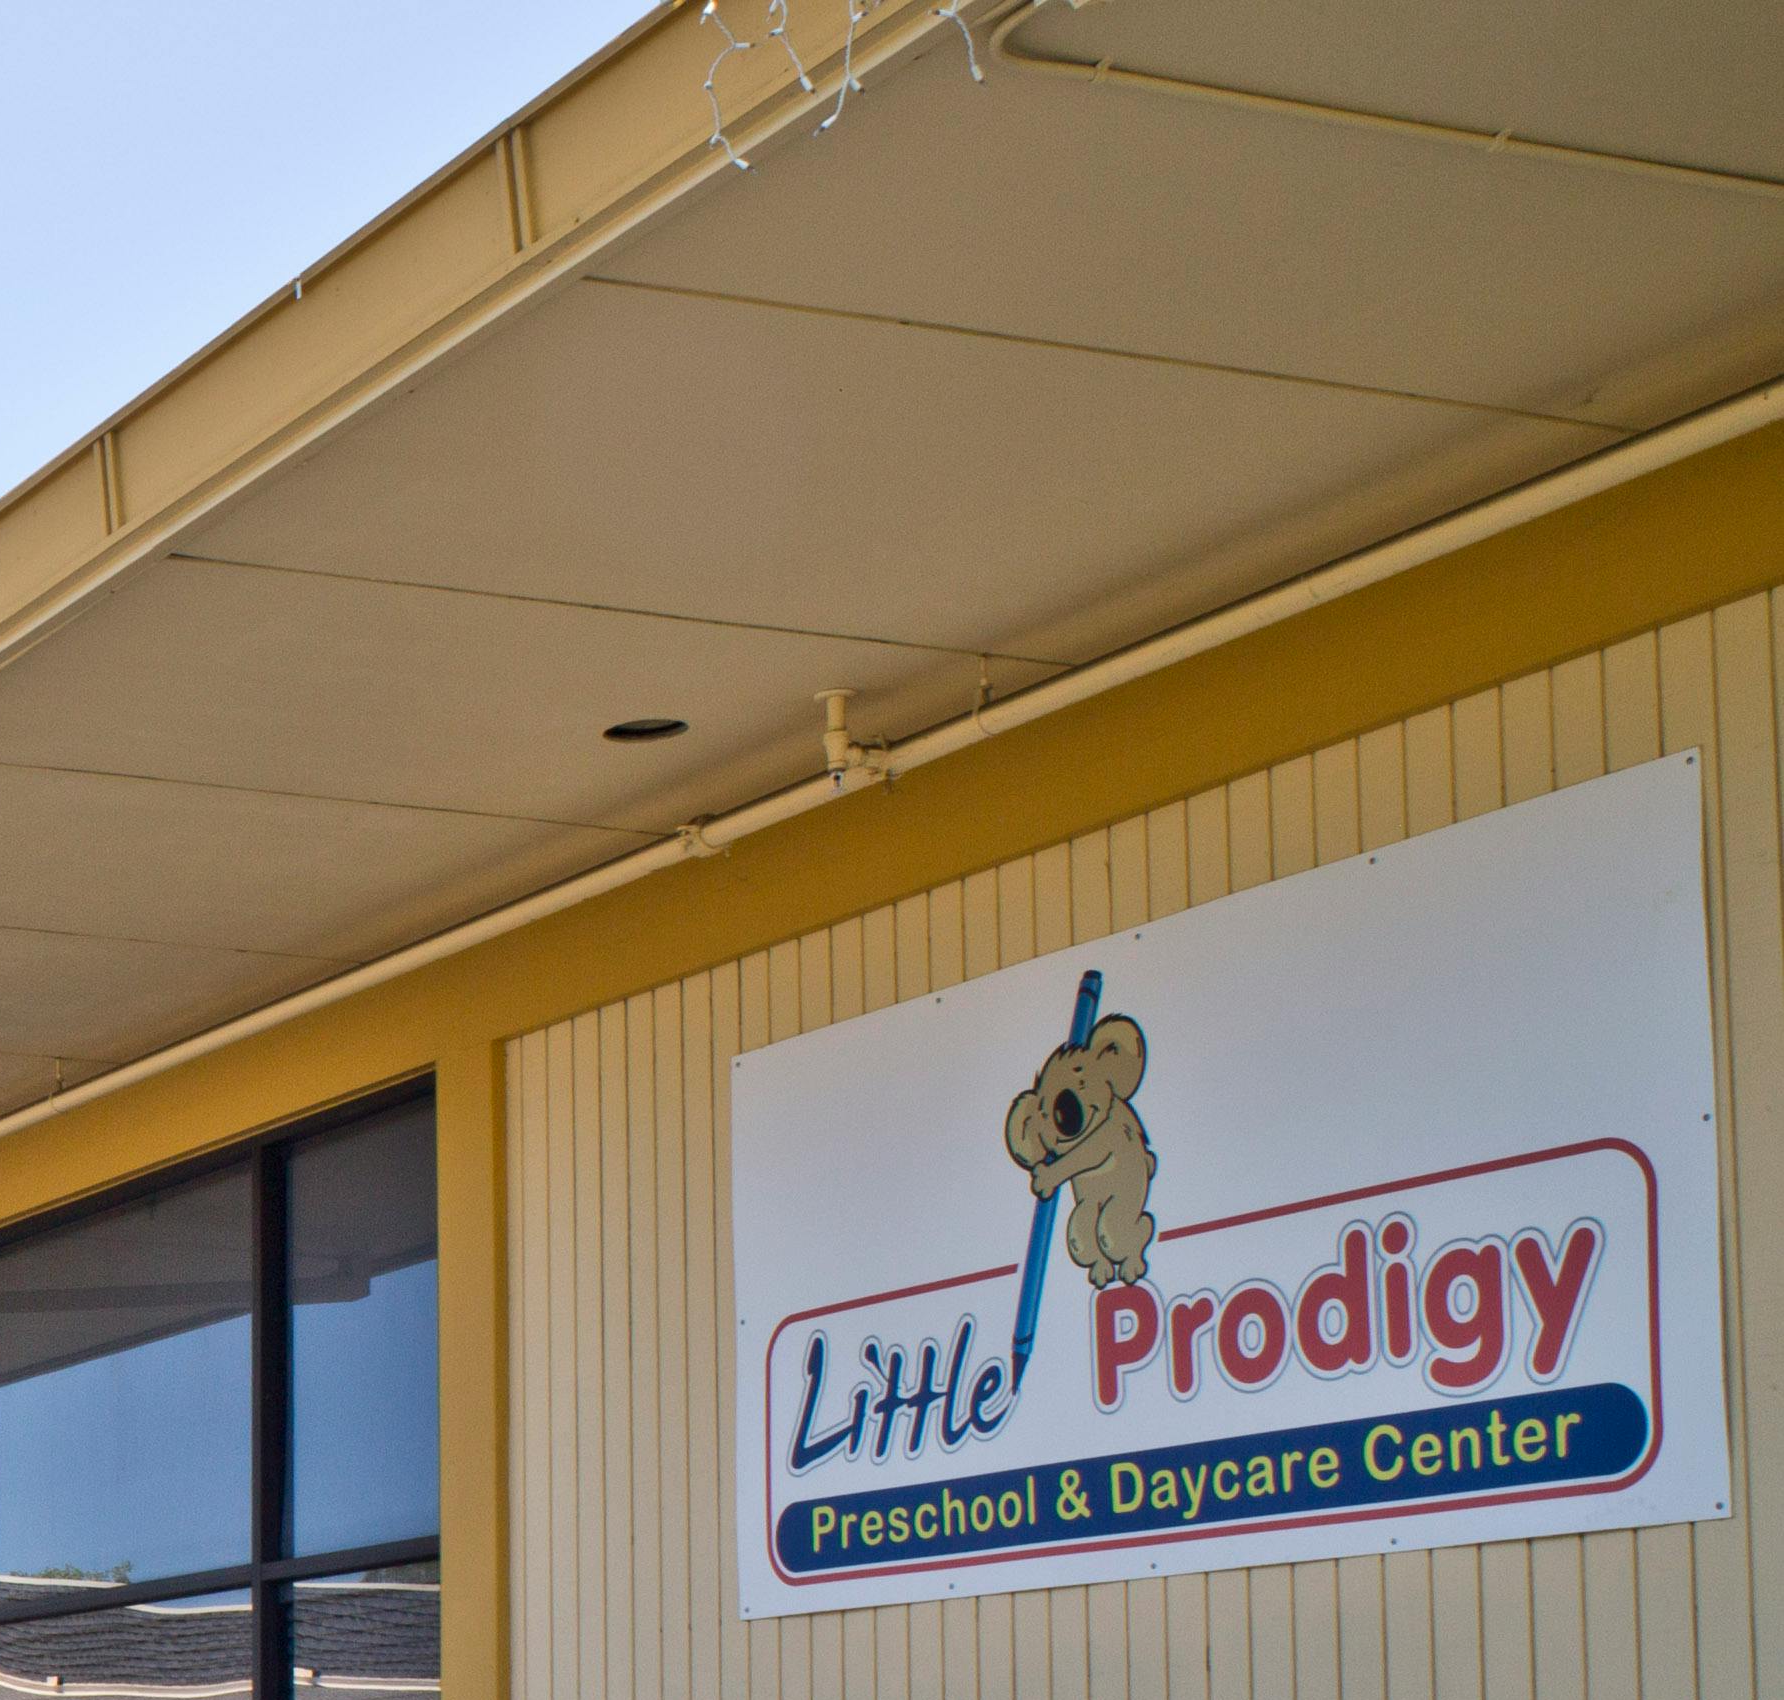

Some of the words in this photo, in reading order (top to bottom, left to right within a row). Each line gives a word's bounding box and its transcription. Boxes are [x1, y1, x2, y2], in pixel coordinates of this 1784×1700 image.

[791, 1320, 1011, 1470] Little
[1094, 1221, 1596, 1406] Prodigy
[812, 1475, 1036, 1552] Preschool
[1056, 1469, 1091, 1520] &
[1110, 1445, 1341, 1519] Daycare
[1363, 1410, 1582, 1482] Center
